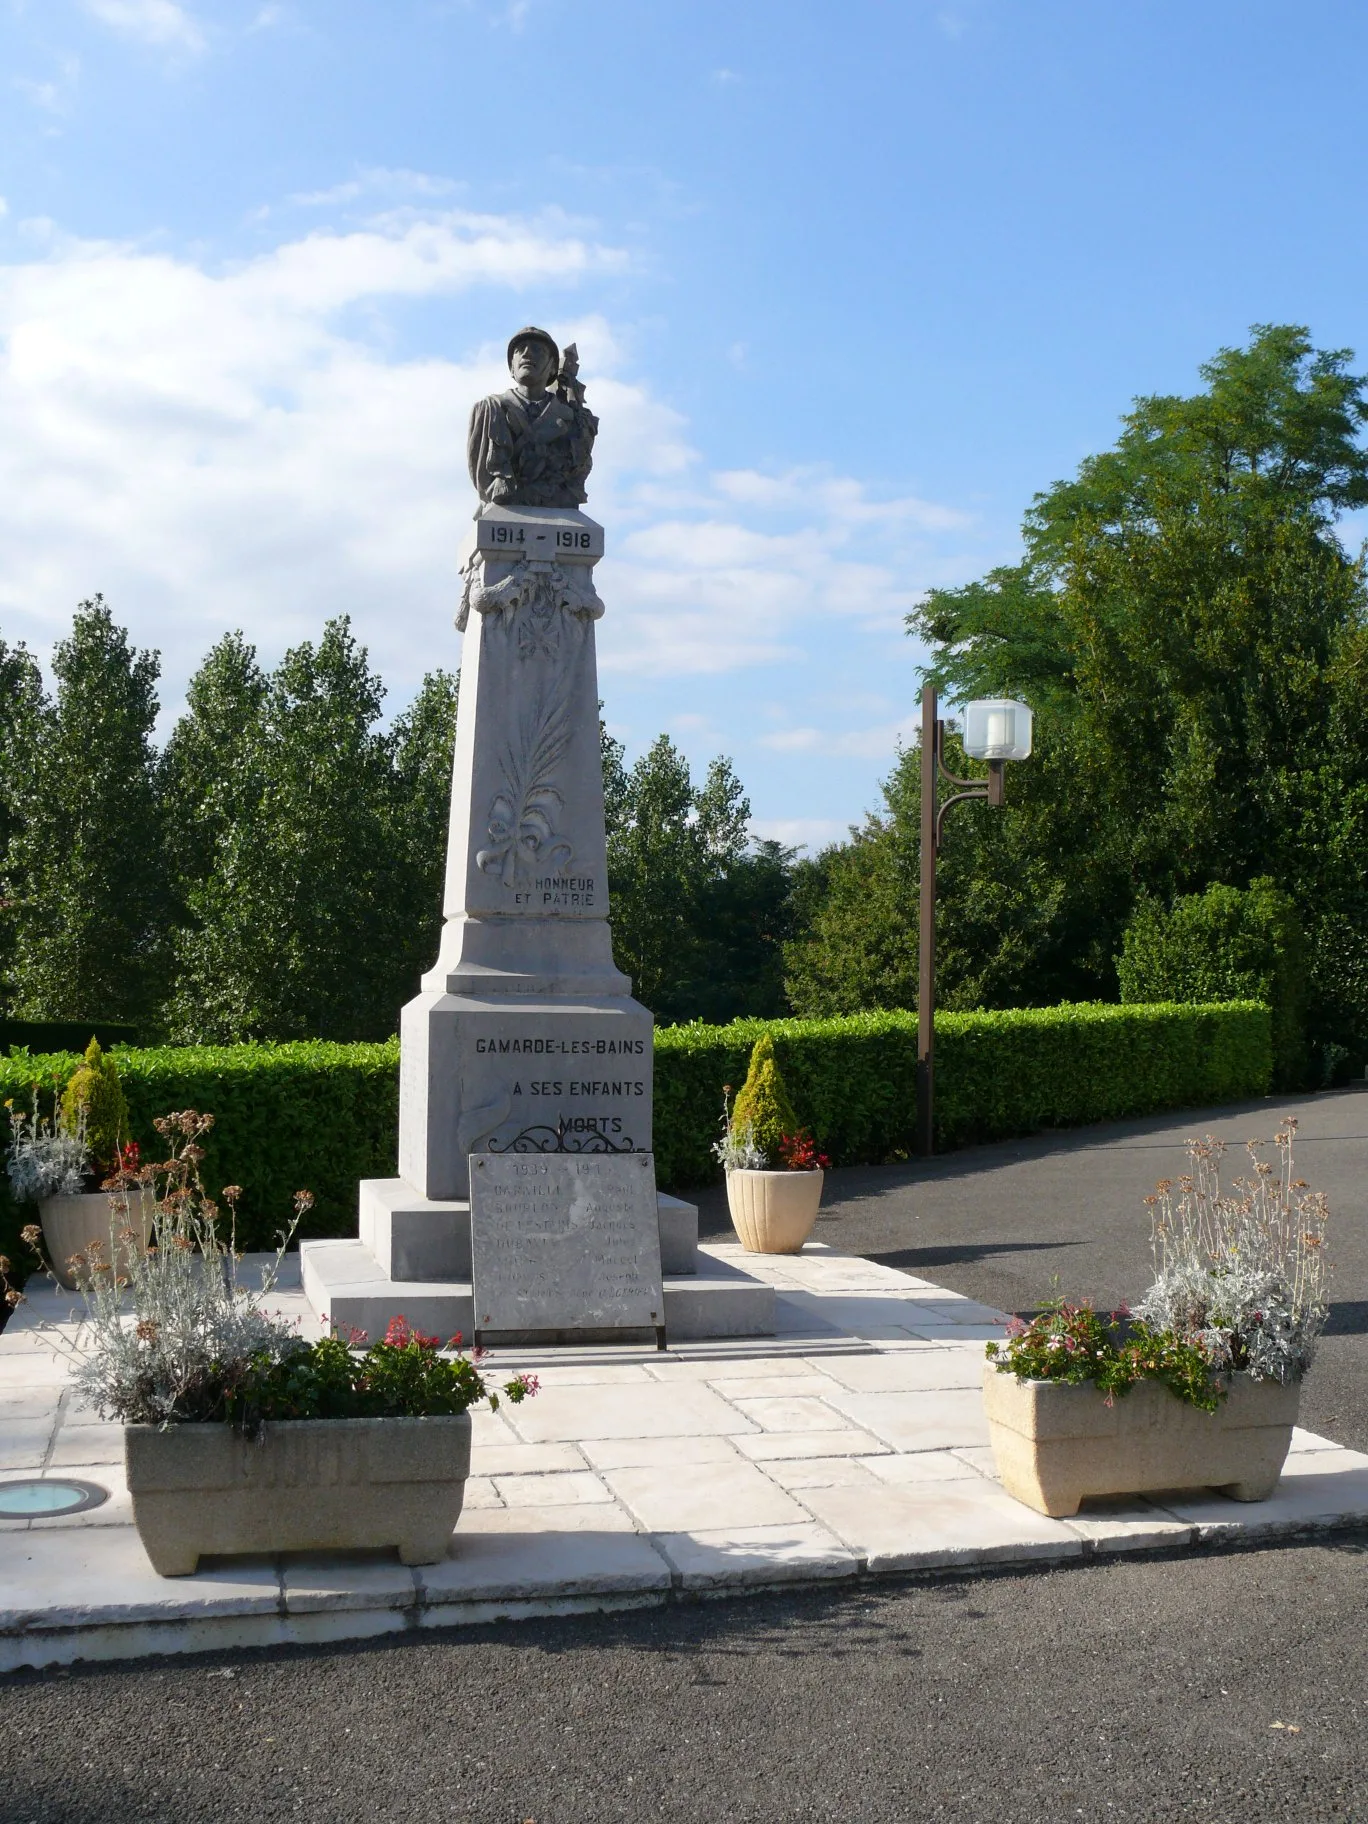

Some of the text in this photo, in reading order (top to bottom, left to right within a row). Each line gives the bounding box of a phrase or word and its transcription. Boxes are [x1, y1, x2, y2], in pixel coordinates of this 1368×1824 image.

[491, 526, 526, 544] 1914
[556, 531, 591, 548] 1918
[535, 877, 594, 891] HONNEUR
[515, 892, 594, 906] ET PATRIE
[476, 1038, 645, 1054] GAMARDE-LES-BAINS
[512, 1081, 644, 1096] A SES ENFANTS
[560, 1117, 623, 1133] MORTS
